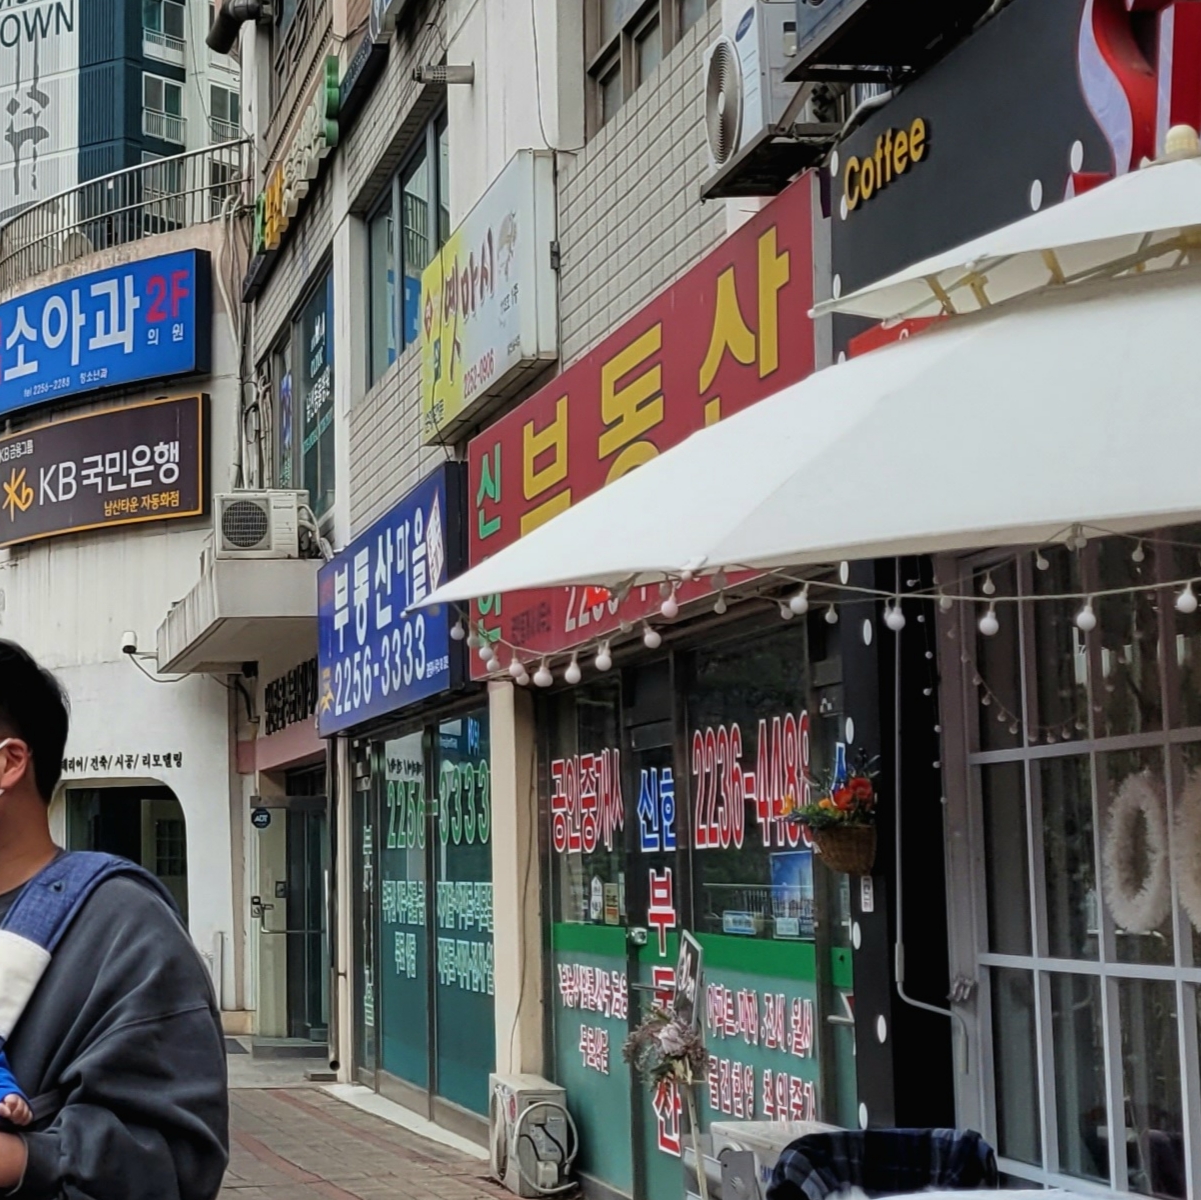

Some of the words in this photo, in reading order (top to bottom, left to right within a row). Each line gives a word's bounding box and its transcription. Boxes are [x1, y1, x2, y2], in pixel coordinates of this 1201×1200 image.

[844, 117, 926, 211] Coffee
[3, 275, 140, 382] 소아과
[145, 270, 189, 324] 2F
[104, 496, 139, 517] 남산타운
[140, 490, 180, 511] 자동화점
[334, 613, 426, 717] 2256-3333
[142, 752, 183, 769] 리모델링
[387, 758, 490, 850] 2256-3333
[551, 747, 625, 854] 공인중개사
[254, 814, 269, 824] ADT
